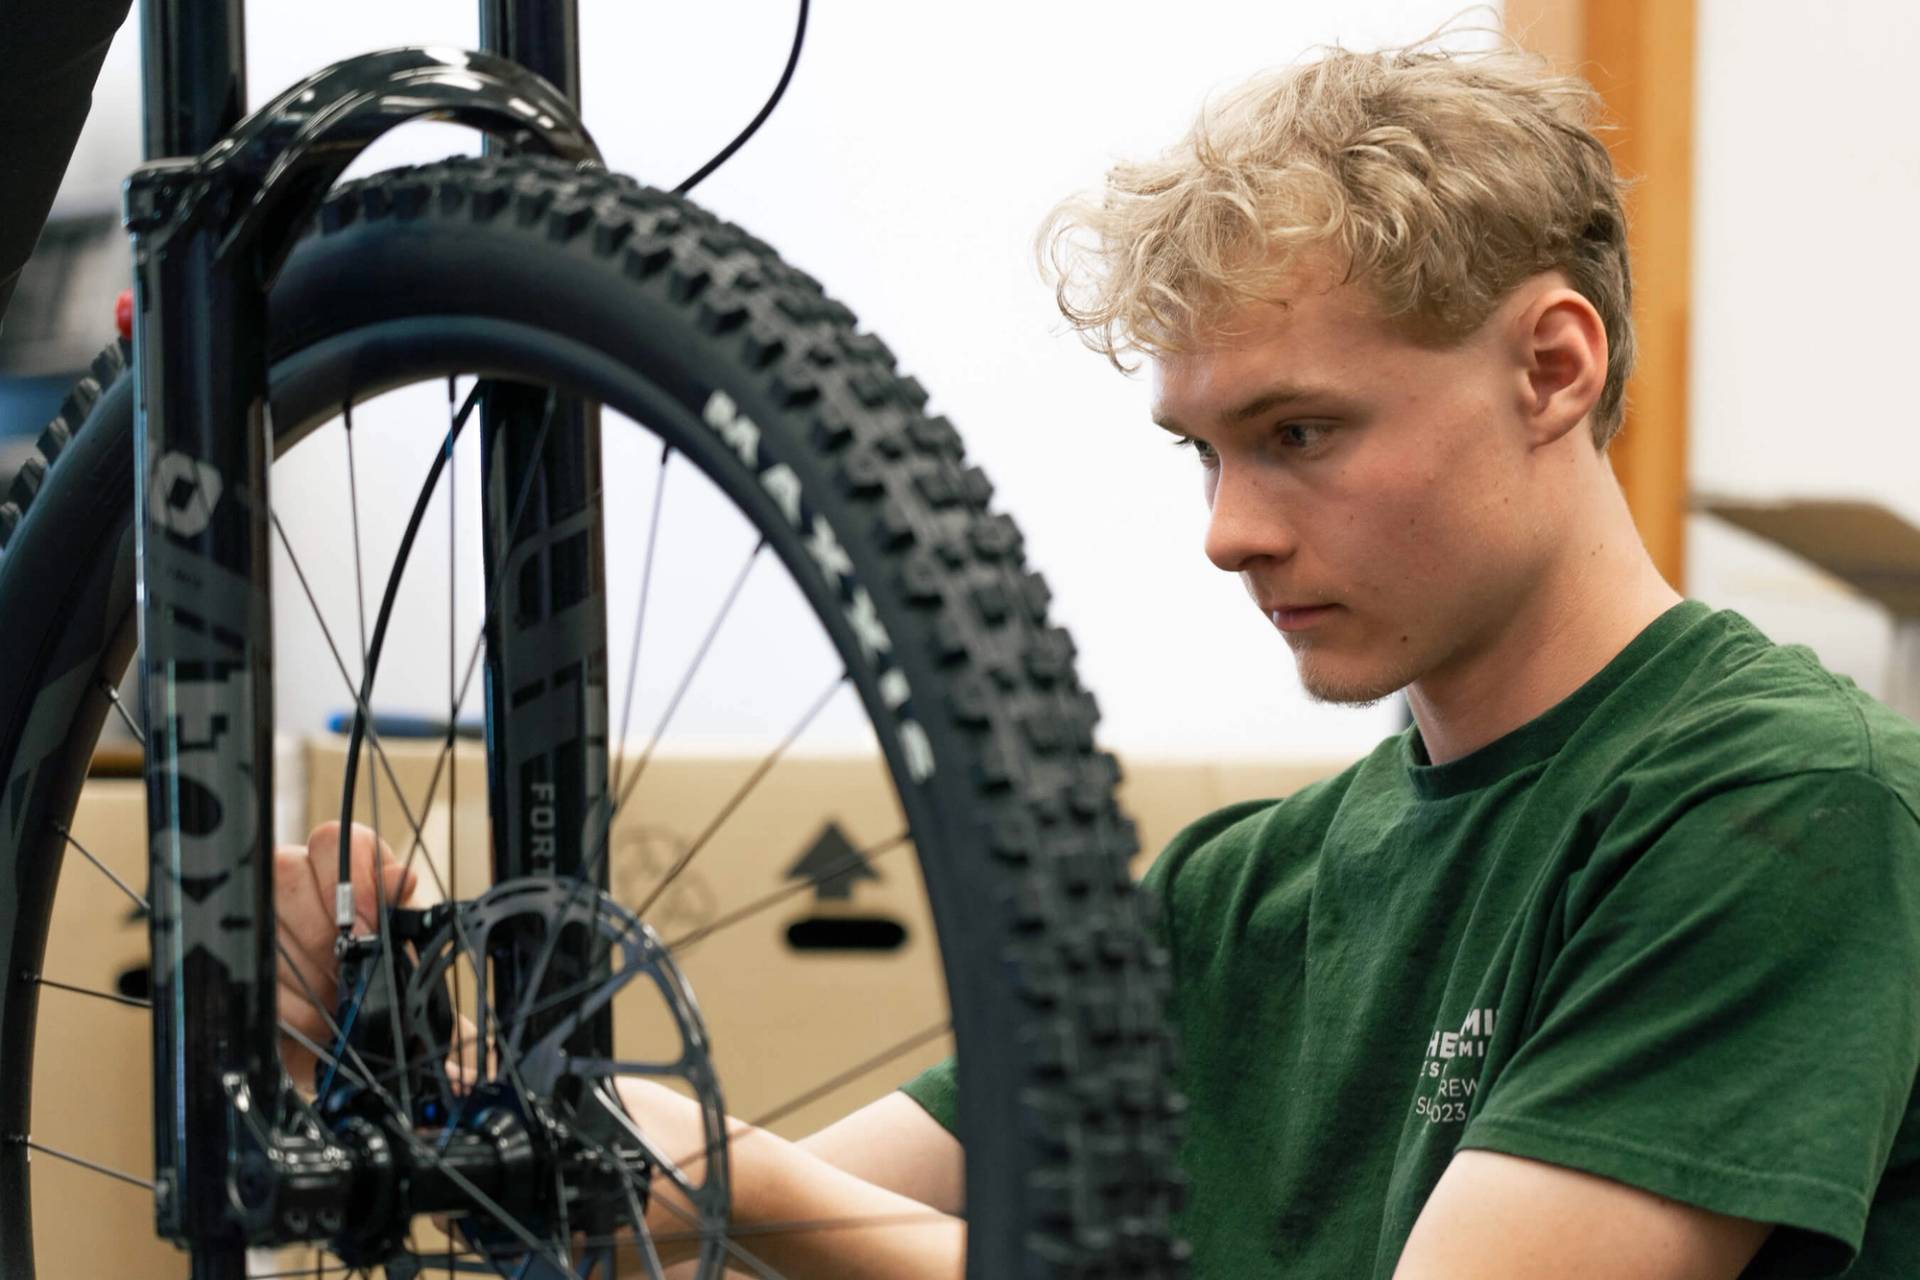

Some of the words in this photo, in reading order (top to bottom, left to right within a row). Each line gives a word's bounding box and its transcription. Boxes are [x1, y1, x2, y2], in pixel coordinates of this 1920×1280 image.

[703, 389, 937, 784] MAXXIS
[148, 664, 260, 985] FOX
[1460, 1008, 1500, 1036] MI
